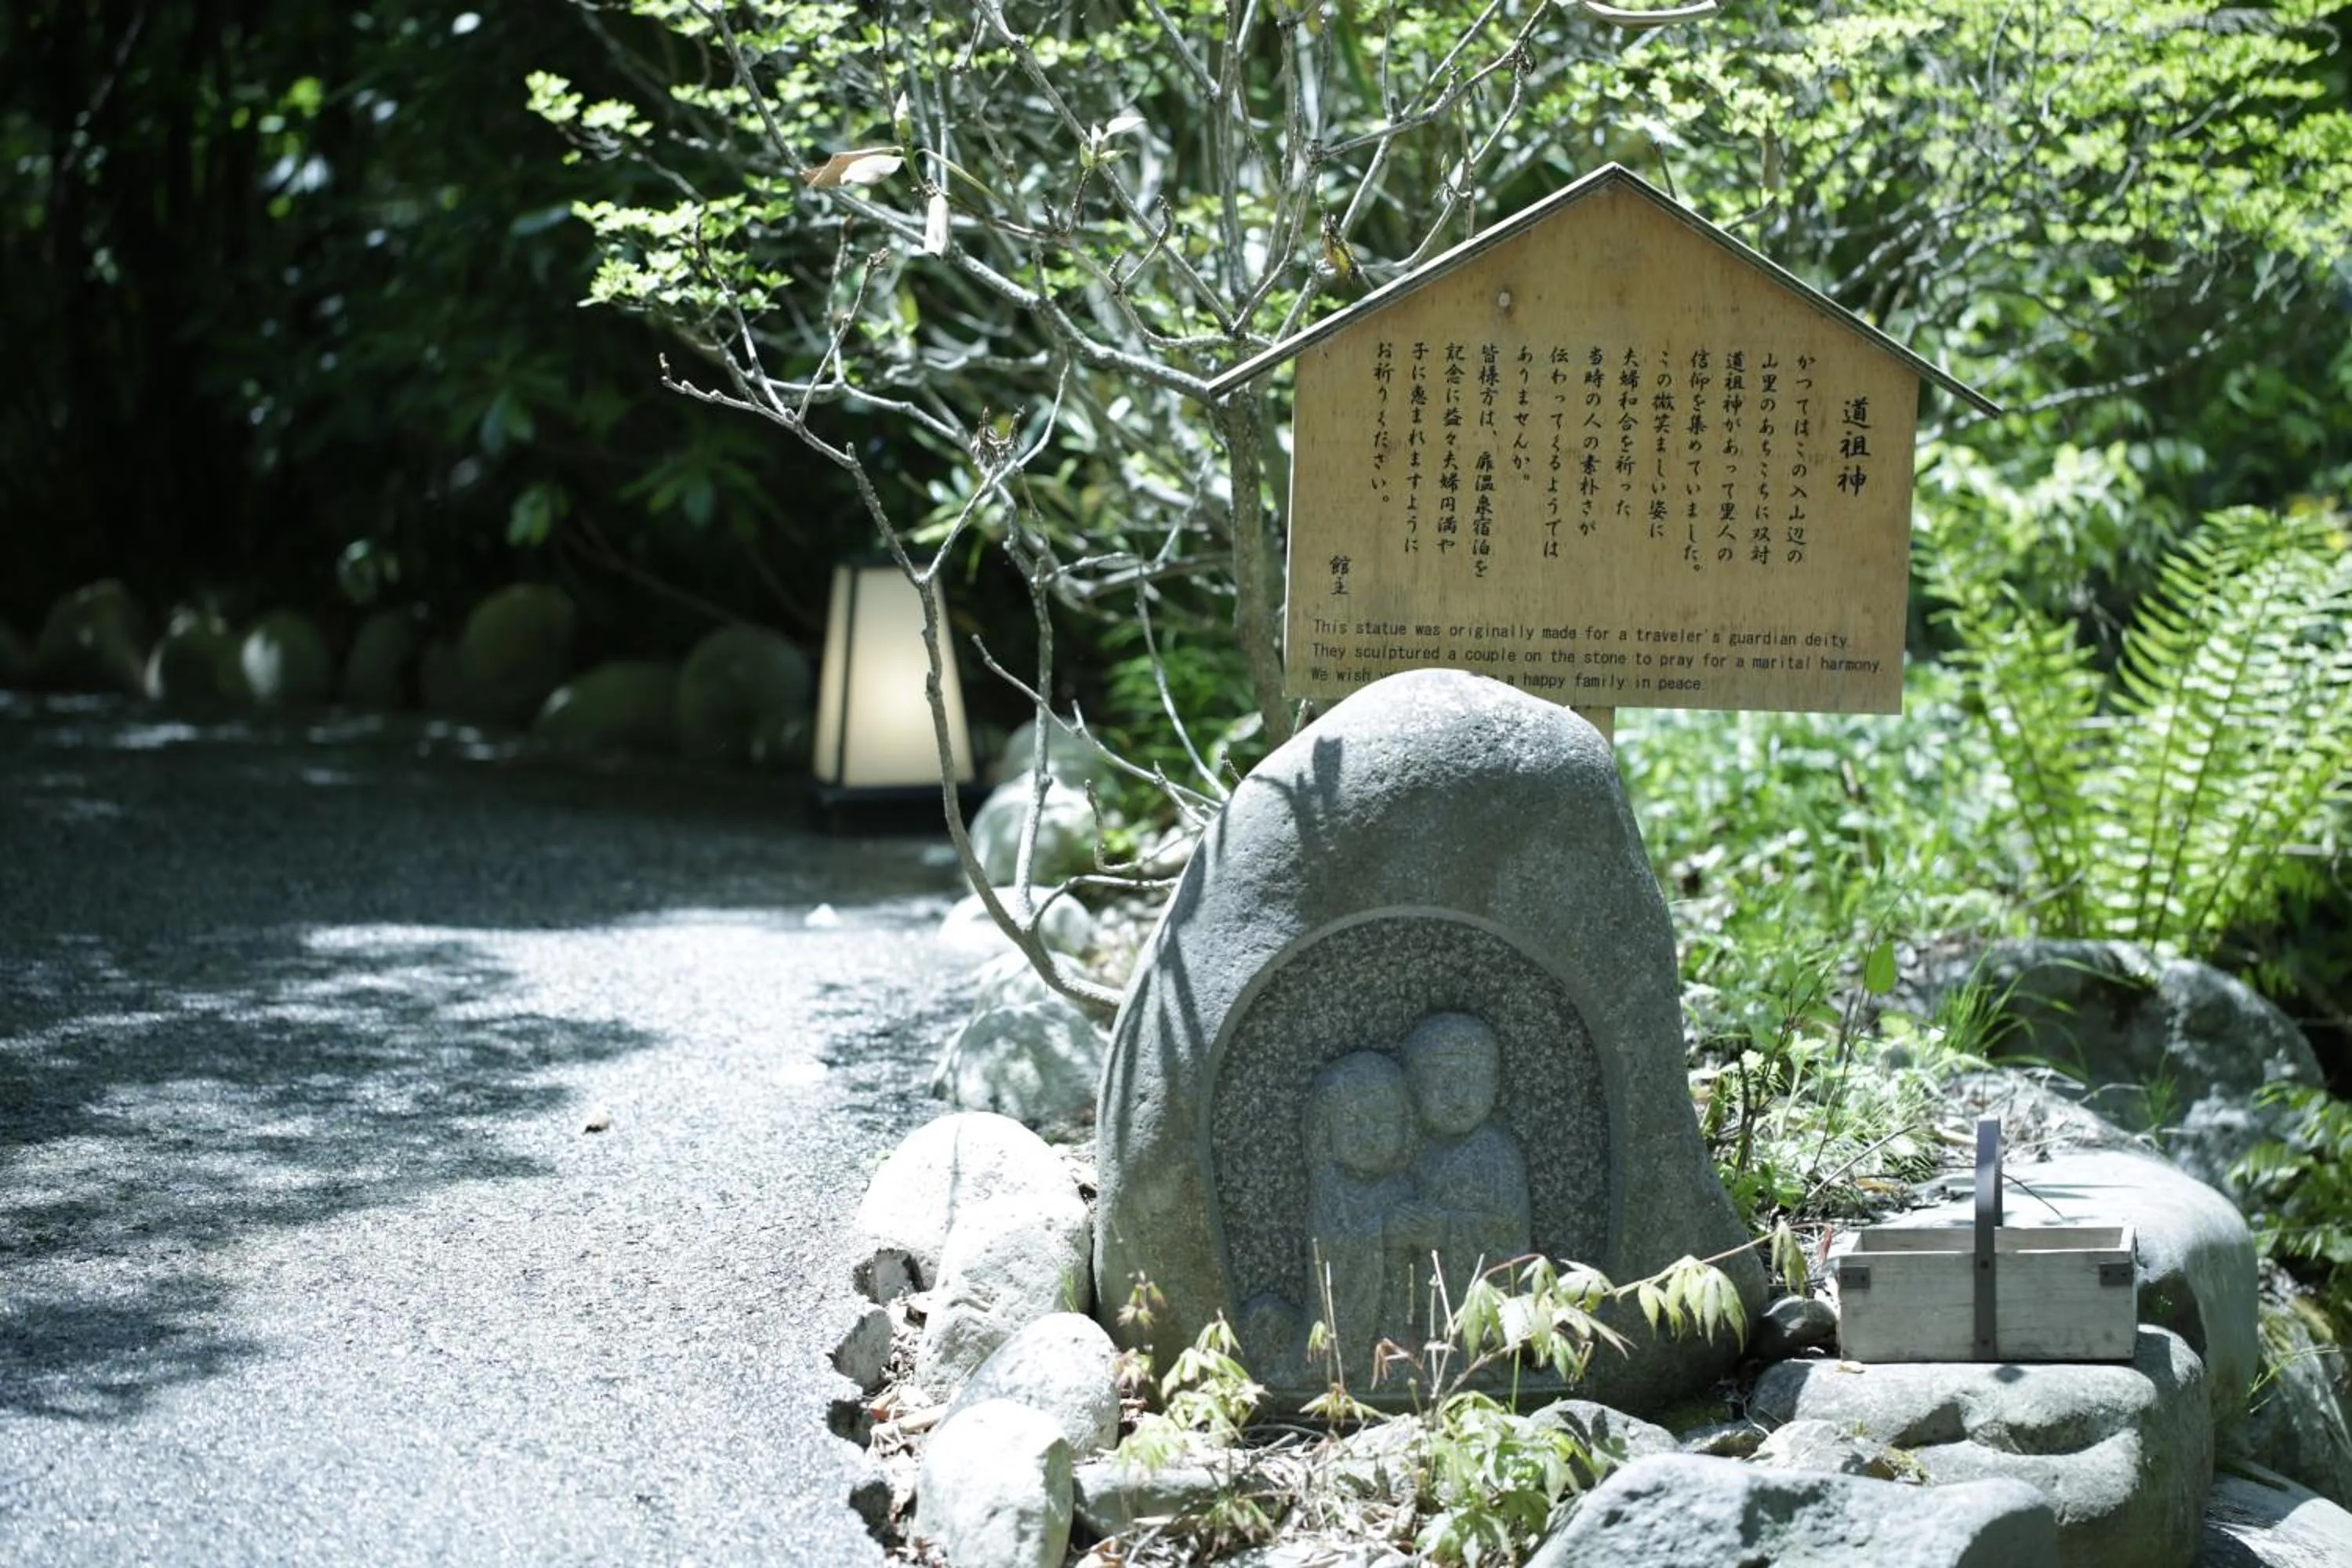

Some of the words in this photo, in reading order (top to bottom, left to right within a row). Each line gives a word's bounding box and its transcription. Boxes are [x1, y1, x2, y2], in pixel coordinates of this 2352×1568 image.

[1838, 397, 1871, 496] 道祖神
[1330, 555, 1351, 595] 館主
[1313, 619, 1347, 634] This
[1356, 622, 1406, 635] statue
[1416, 626, 1440, 636] was
[1450, 623, 1535, 640] originally
[1543, 626, 1577, 638] made
[1585, 626, 1610, 640] for
[1618, 630, 1628, 641] a
[1637, 628, 1720, 644] traveler's
[1729, 631, 1796, 647] guardian
[1312, 644, 1346, 659] They
[1354, 645, 1439, 661] sculptured
[1446, 649, 1456, 661] a
[1465, 649, 1515, 664] couple
[1525, 652, 1542, 662] on
[1552, 650, 1575, 663] the
[1584, 653, 1626, 665] stone
[1636, 653, 1651, 666] to
[1661, 655, 1694, 669] pray
[1704, 653, 1727, 667] for
[1735, 657, 1745, 668] a
[1752, 656, 1810, 670] marital
[1820, 657, 1882, 673] harmony.
[1311, 667, 1327, 681] We
[1337, 667, 1370, 681] wish
[1506, 674, 1515, 686] a
[1524, 673, 1565, 688] happy
[1574, 674, 1624, 689] family
[1635, 677, 1650, 688] in
